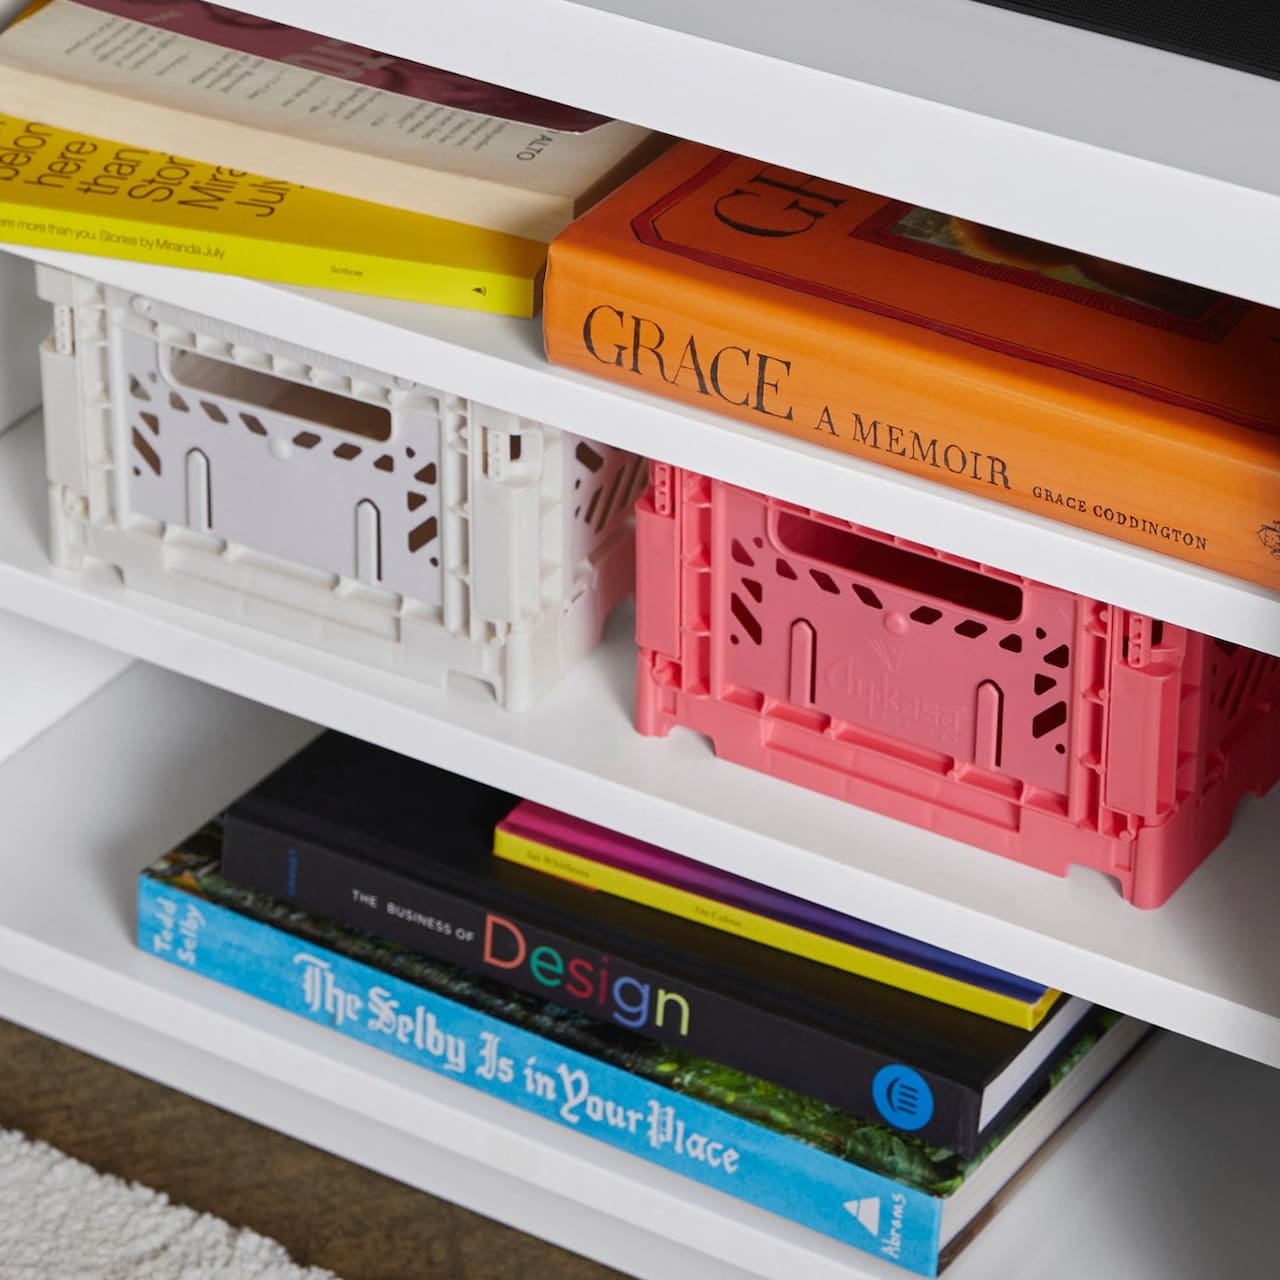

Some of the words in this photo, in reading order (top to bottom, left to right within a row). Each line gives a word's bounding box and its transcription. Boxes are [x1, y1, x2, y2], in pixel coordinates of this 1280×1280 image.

[22, 140, 98, 189] here
[76, 147, 152, 197] than
[516, 133, 553, 161] ALTO
[127, 151, 196, 203] Stor
[17, 219, 47, 234] more
[48, 221, 73, 238] than
[99, 229, 140, 247] Stories
[140, 233, 154, 251] by
[155, 238, 202, 257] Miranda
[203, 244, 226, 260] July
[581, 303, 795, 422] GRACE
[813, 404, 842, 439] A
[851, 411, 1012, 491] MEMOIR
[1031, 485, 1088, 514] GRACE
[1092, 504, 1209, 552] CODDINGTON
[153, 896, 177, 952] Todd
[176, 903, 208, 966] Selby
[351, 888, 380, 910] THE
[386, 901, 452, 937] BUSINESS
[454, 923, 476, 943] OF
[482, 912, 692, 1038] Design
[292, 951, 364, 1026] The
[367, 985, 467, 1075] Selby
[475, 1030, 516, 1083] Is
[522, 1054, 558, 1101] in
[556, 1062, 645, 1135] Your
[645, 1098, 742, 1174] Place
[880, 1192, 907, 1260] Abrams
